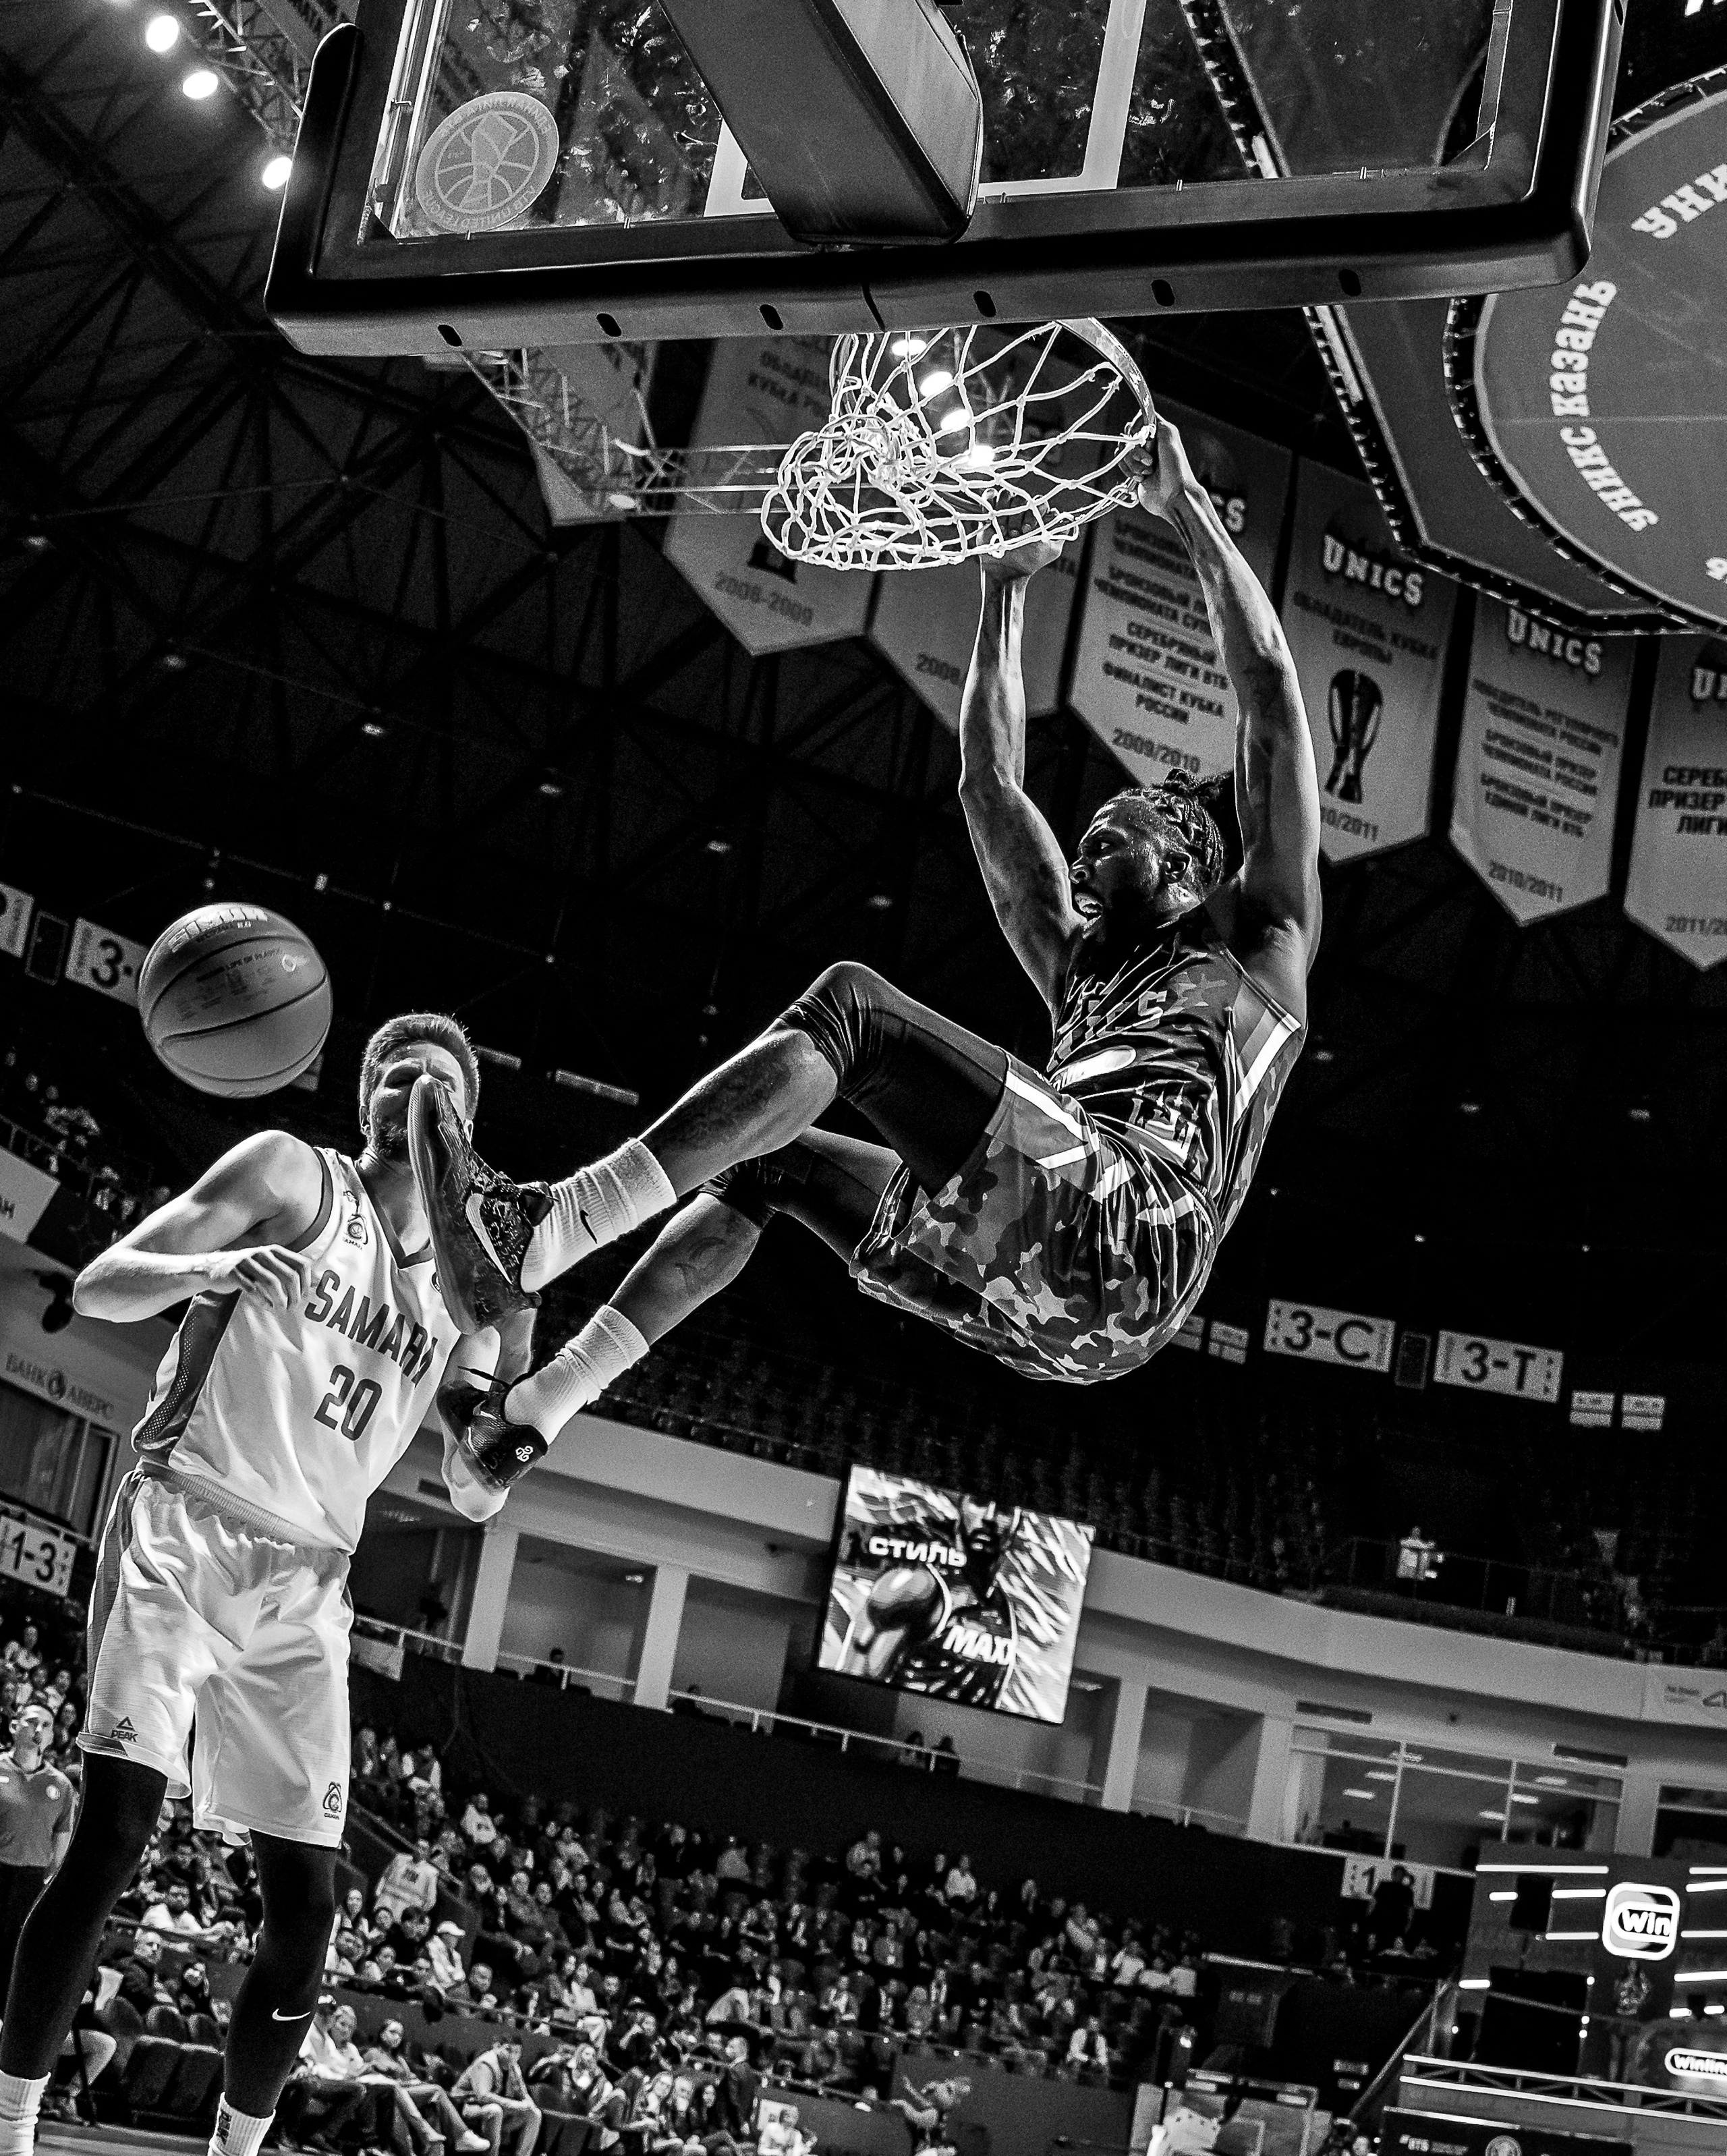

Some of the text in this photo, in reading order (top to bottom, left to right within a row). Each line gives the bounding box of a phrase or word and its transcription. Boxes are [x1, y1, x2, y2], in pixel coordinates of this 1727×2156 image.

[1323, 534, 1423, 605] UNICS
[1507, 608, 1602, 673] UNICS
[1663, 766, 1727, 788] СЕРЕБ
[314, 1365, 383, 1441] 20
[13, 1531, 56, 1583] 1-3
[868, 1535, 968, 1568] СТИЛЬ
[111, 1729, 139, 1742] PEAK
